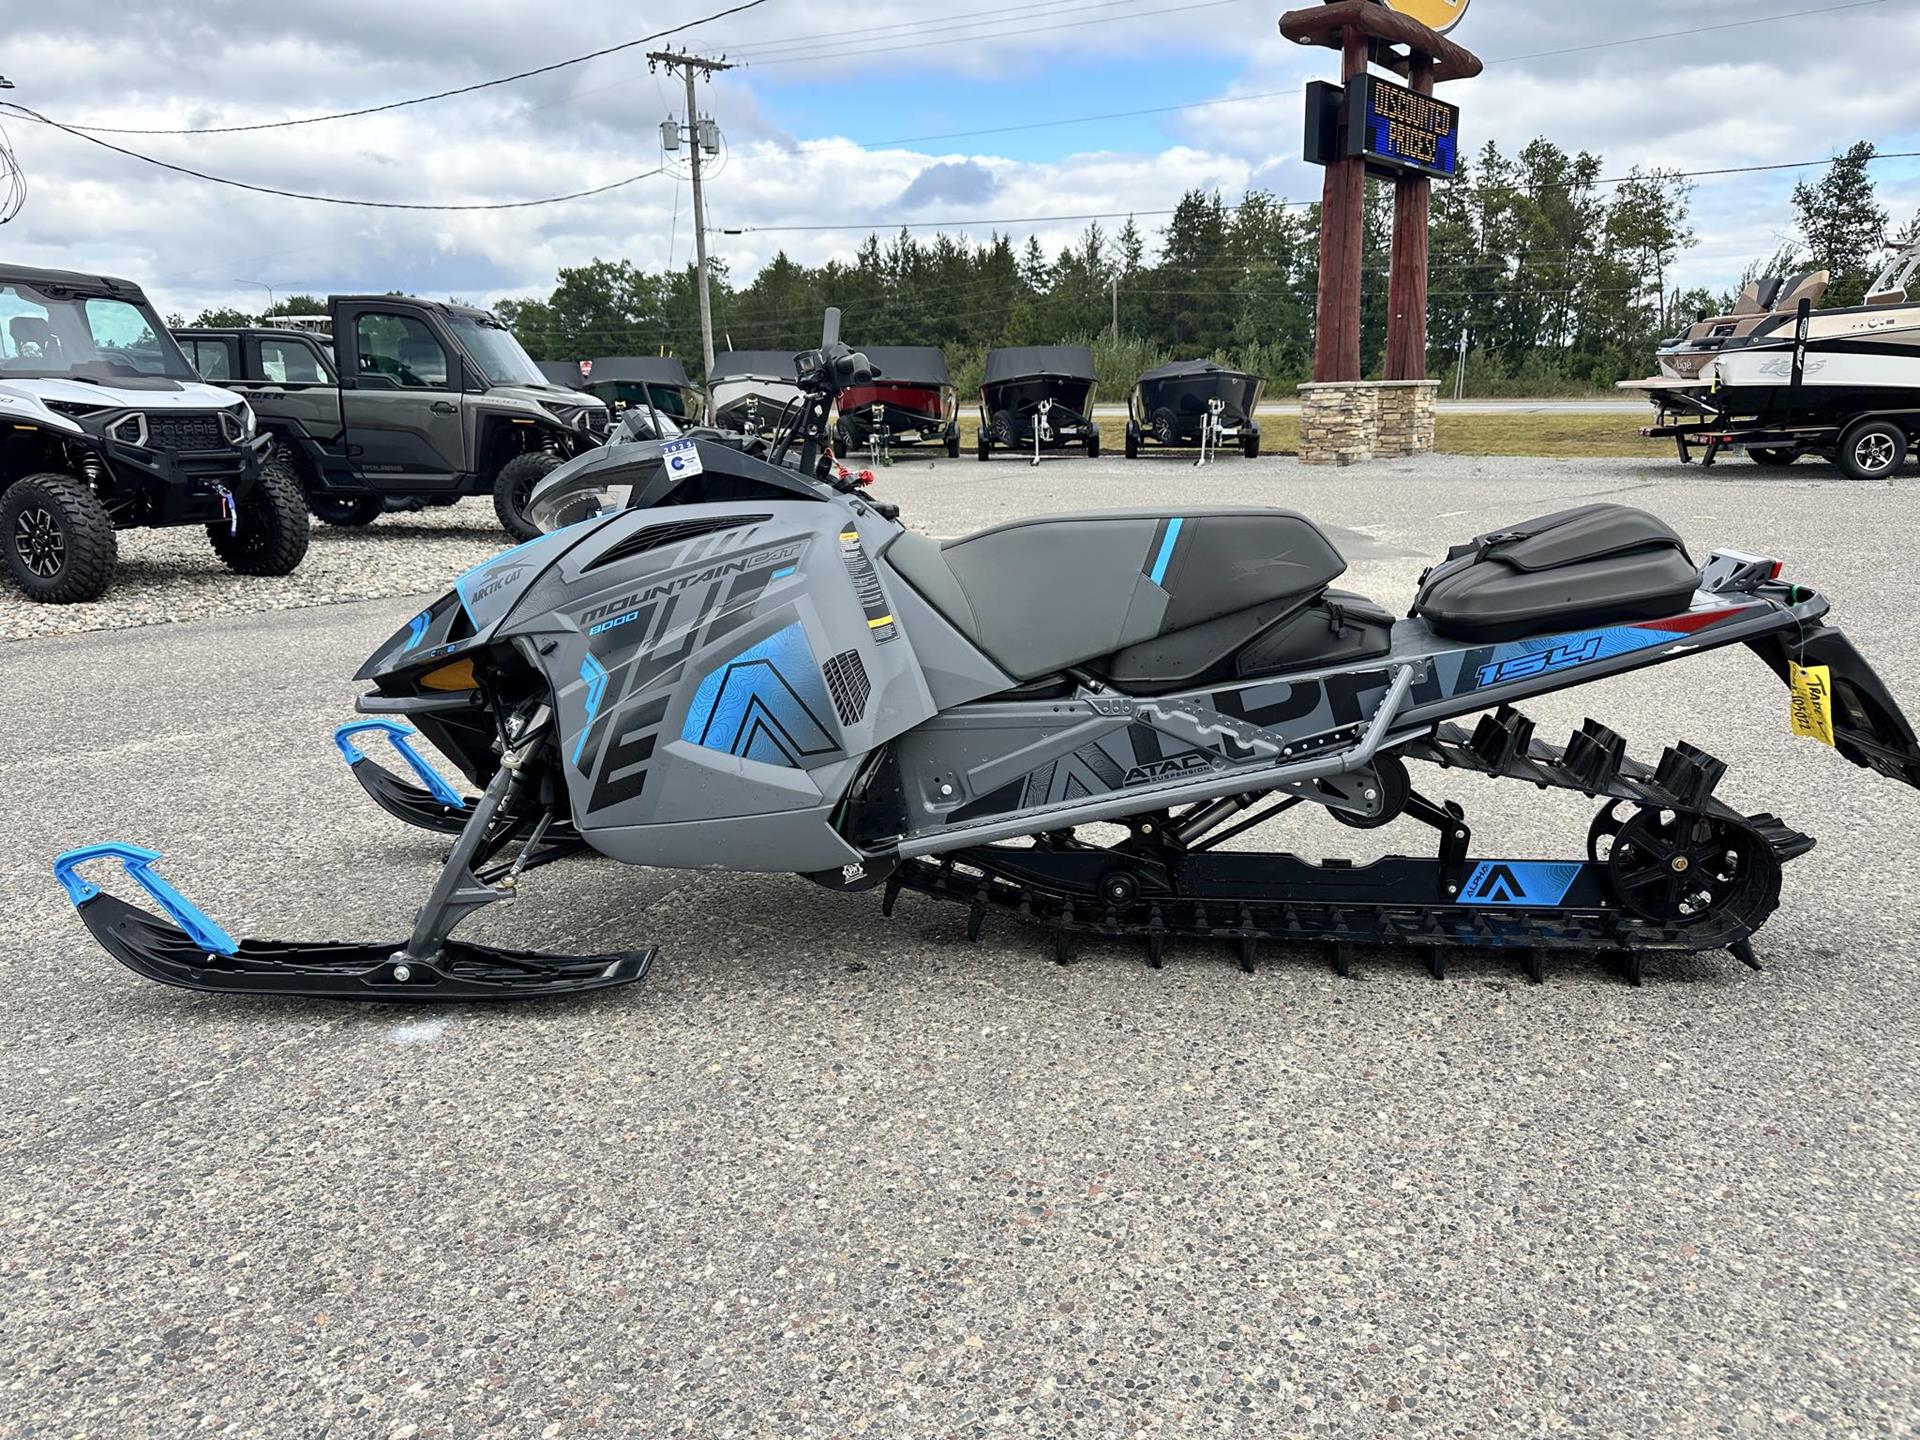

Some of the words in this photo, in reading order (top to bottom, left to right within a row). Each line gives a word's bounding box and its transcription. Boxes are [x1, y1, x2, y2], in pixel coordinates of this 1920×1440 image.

[1375, 82, 1451, 135] DISCOUNTED
[151, 423, 219, 435] POLARIS
[663, 441, 692, 454] 2025
[362, 464, 404, 472] POLARIS
[471, 578, 505, 605] ARCTIC
[505, 568, 524, 585] CAT
[588, 610, 640, 636] 8000
[1475, 636, 1603, 689] 154
[1124, 755, 1208, 781] ATAC
[1151, 766, 1211, 781] SUSPENSION
[1467, 864, 1489, 898] ALPHA
